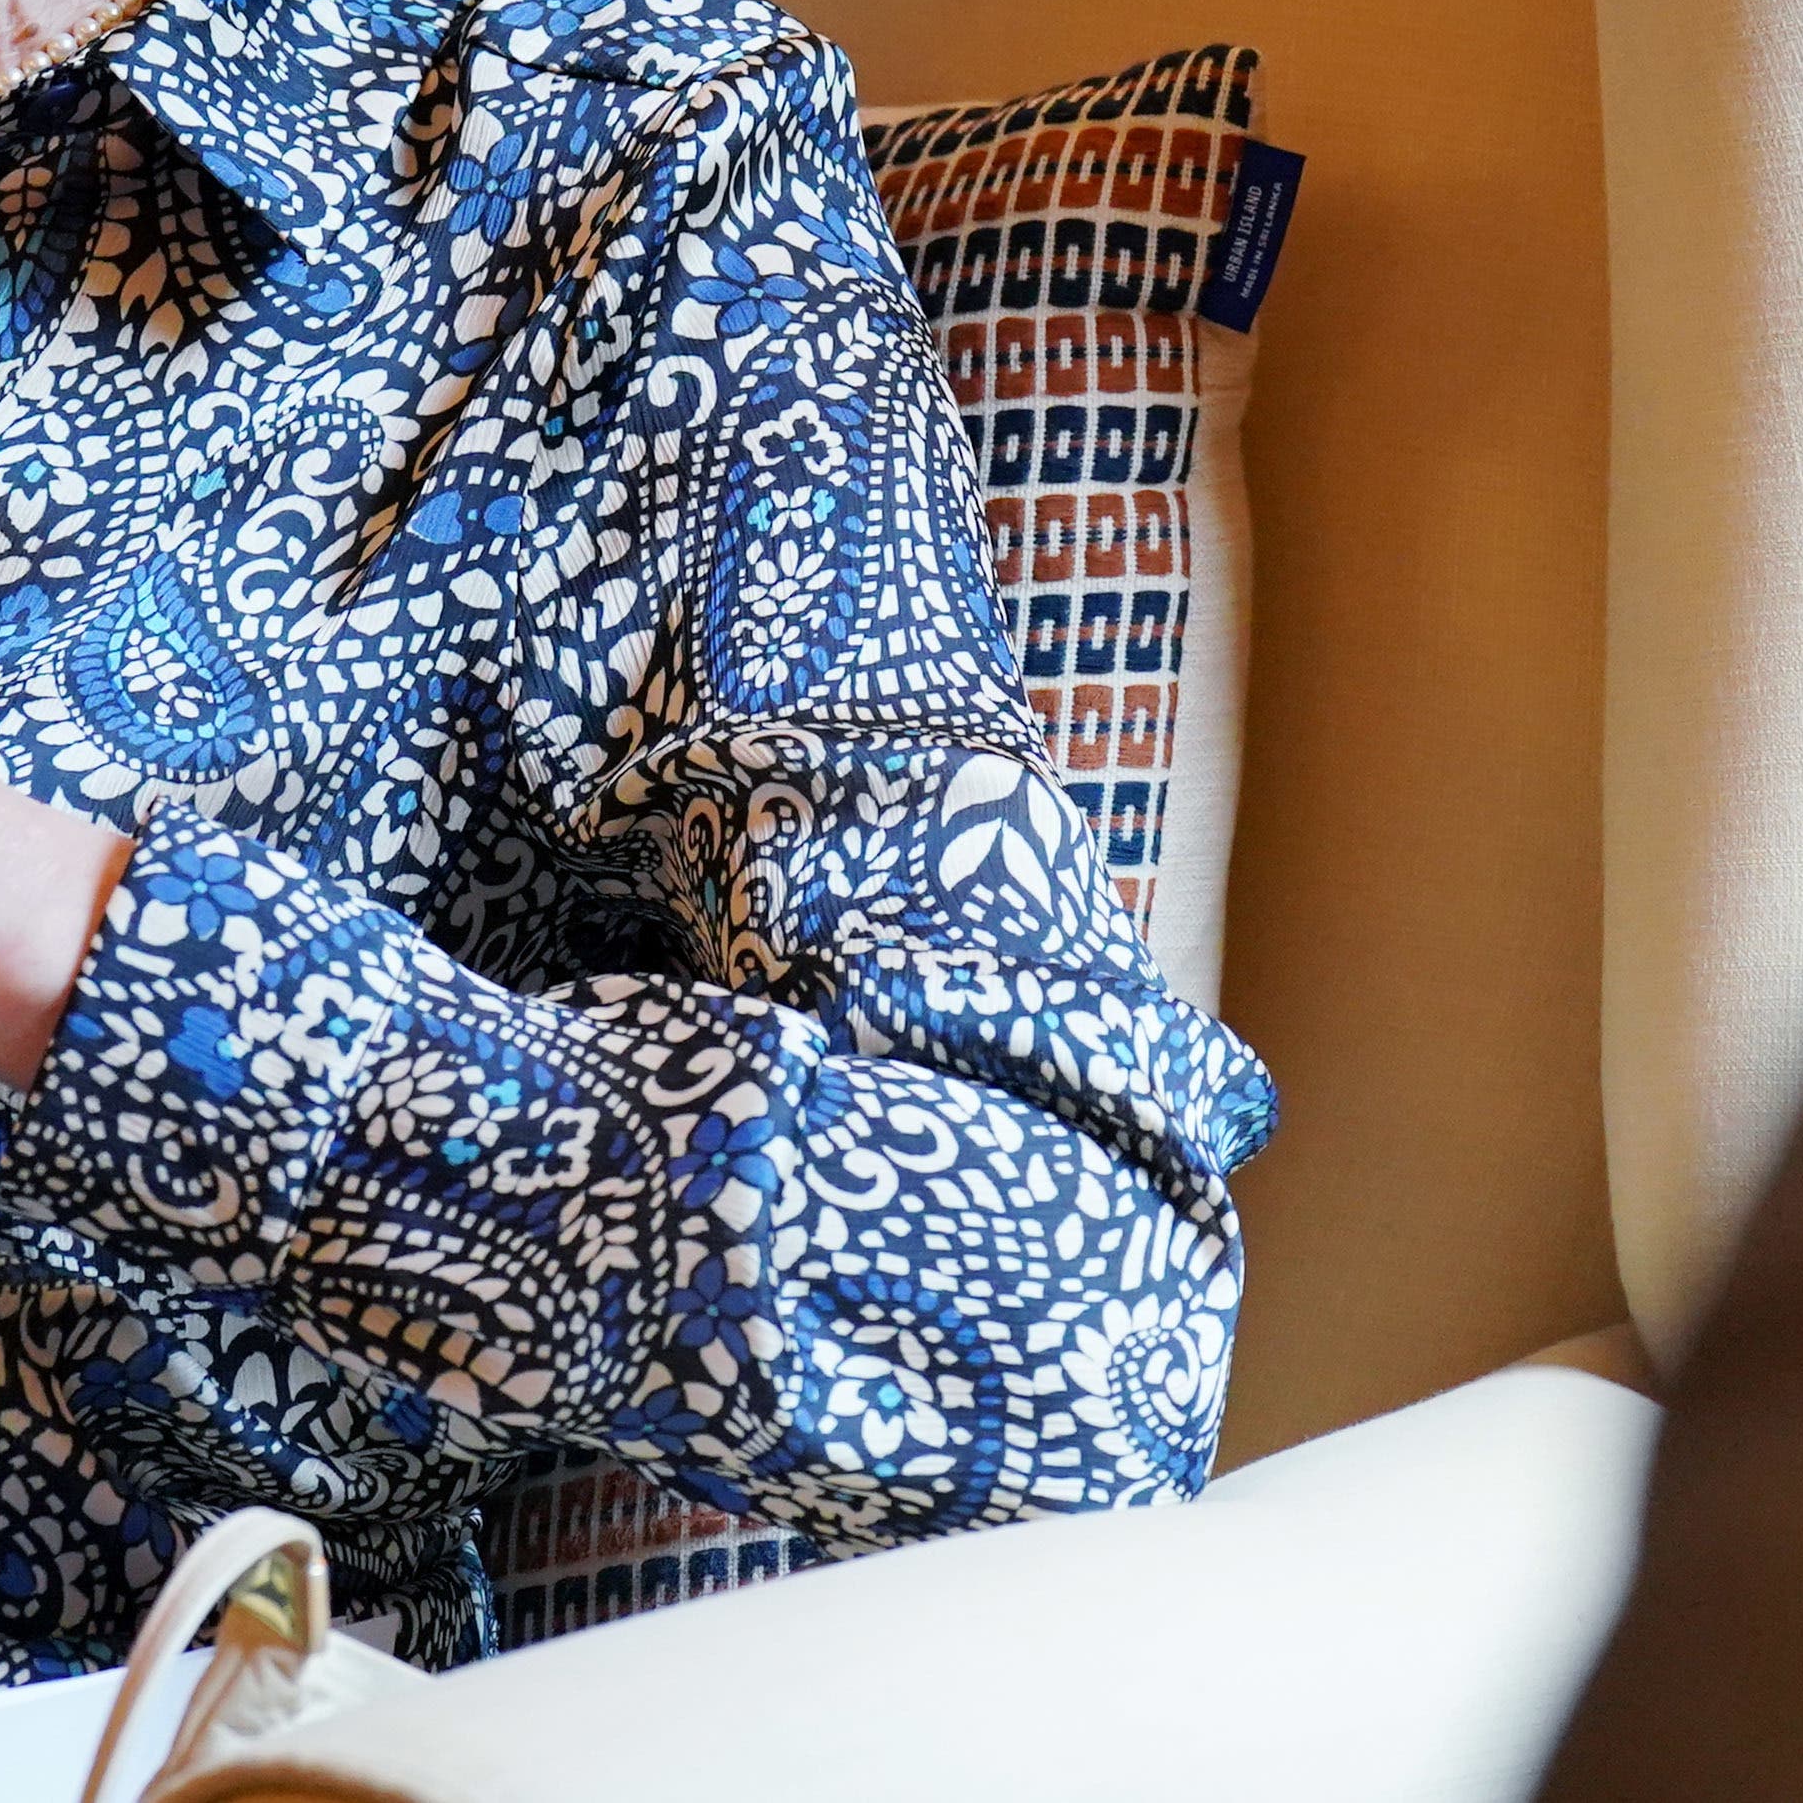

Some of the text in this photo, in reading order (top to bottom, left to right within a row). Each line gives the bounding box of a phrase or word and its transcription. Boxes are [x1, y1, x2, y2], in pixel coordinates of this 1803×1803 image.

[1223, 185, 1263, 283] URBAN ISLAND
[1240, 182, 1284, 299] MADE IN SRI LANKA
